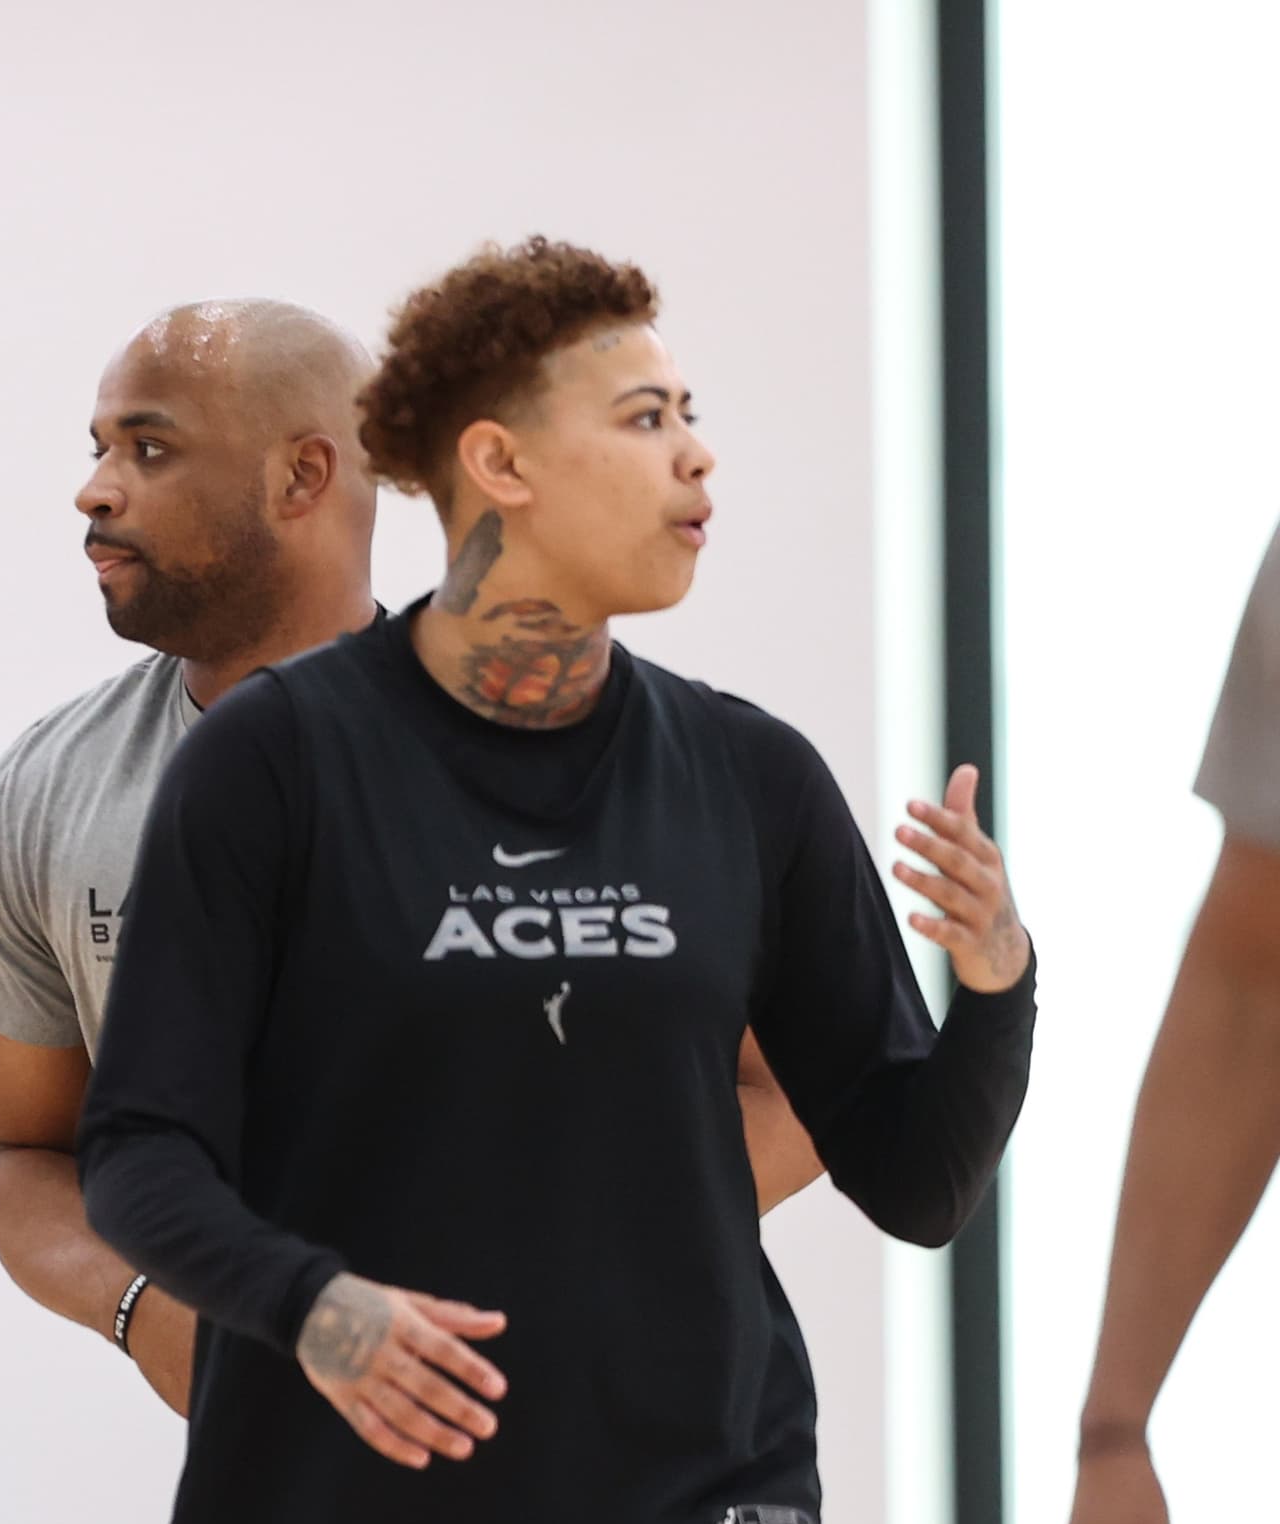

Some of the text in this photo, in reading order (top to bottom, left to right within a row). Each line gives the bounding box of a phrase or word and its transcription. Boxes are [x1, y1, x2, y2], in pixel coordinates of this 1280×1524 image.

[449, 883, 640, 904] LAS VEGAS
[422, 903, 678, 960] ACES
